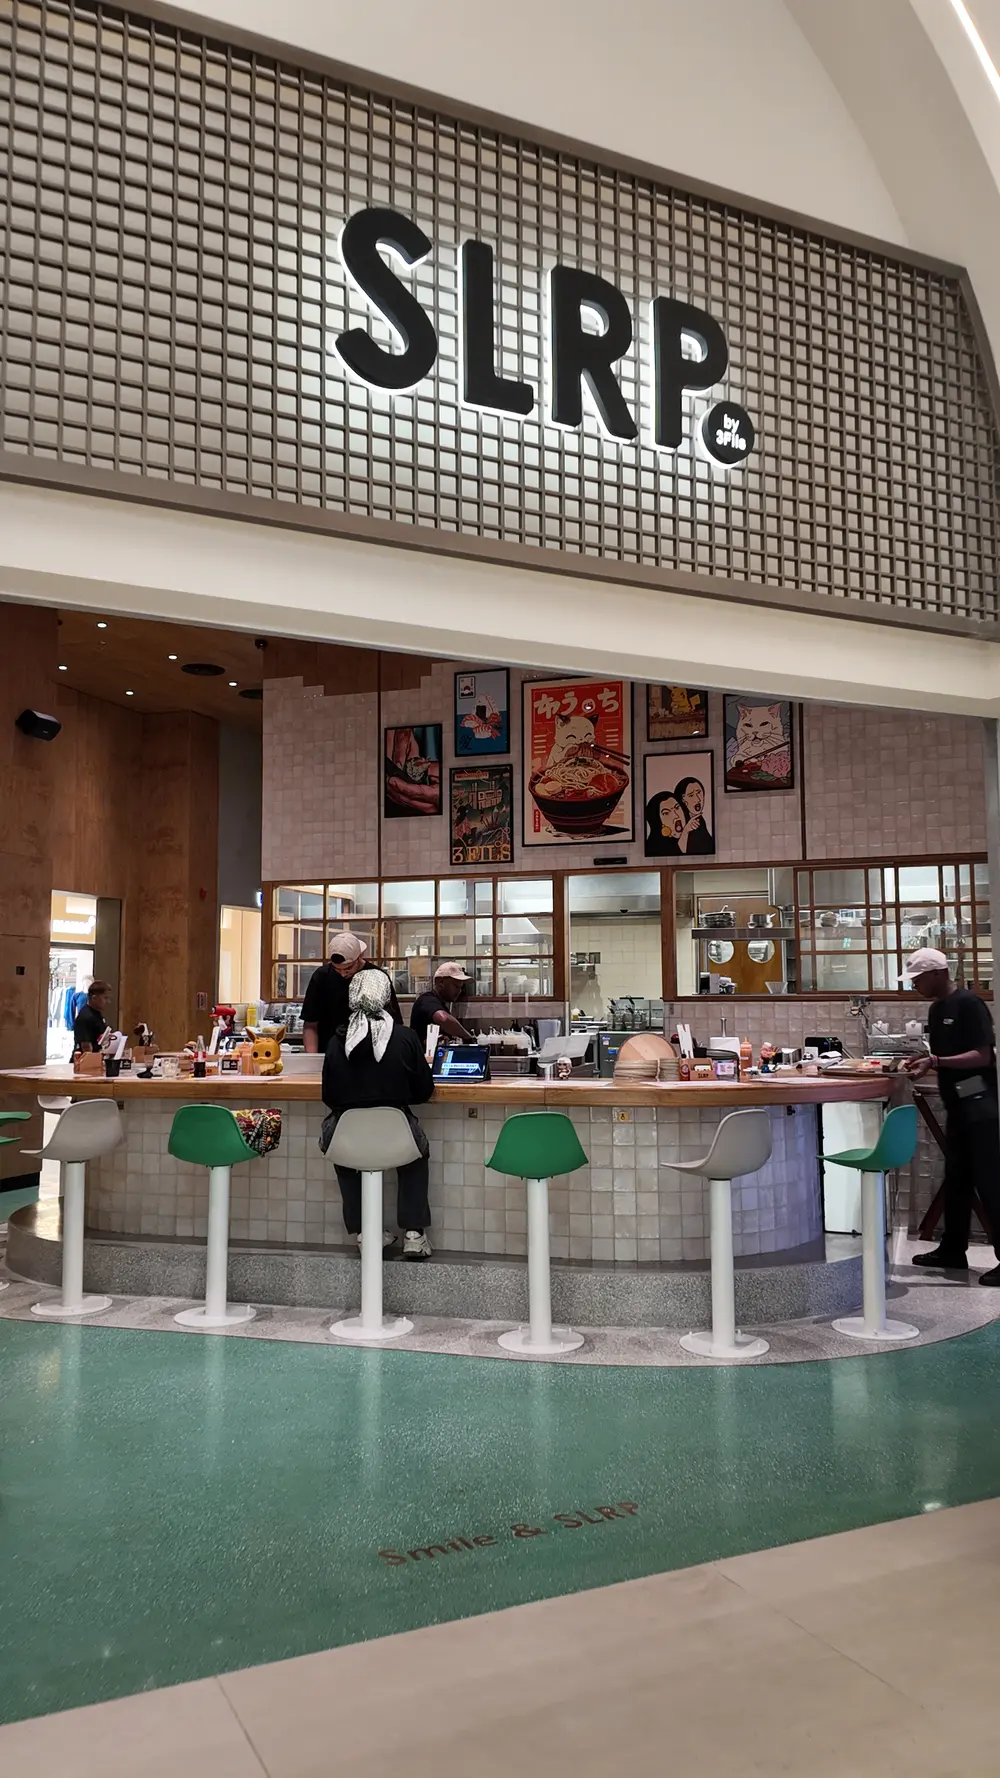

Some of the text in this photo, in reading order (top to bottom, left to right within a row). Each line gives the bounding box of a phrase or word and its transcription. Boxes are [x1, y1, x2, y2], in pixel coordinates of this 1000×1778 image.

[334, 206, 729, 449] SLRP
[723, 413, 740, 434] by
[452, 847, 464, 863] 3
[377, 1501, 639, 1567] Smile & SLRP
